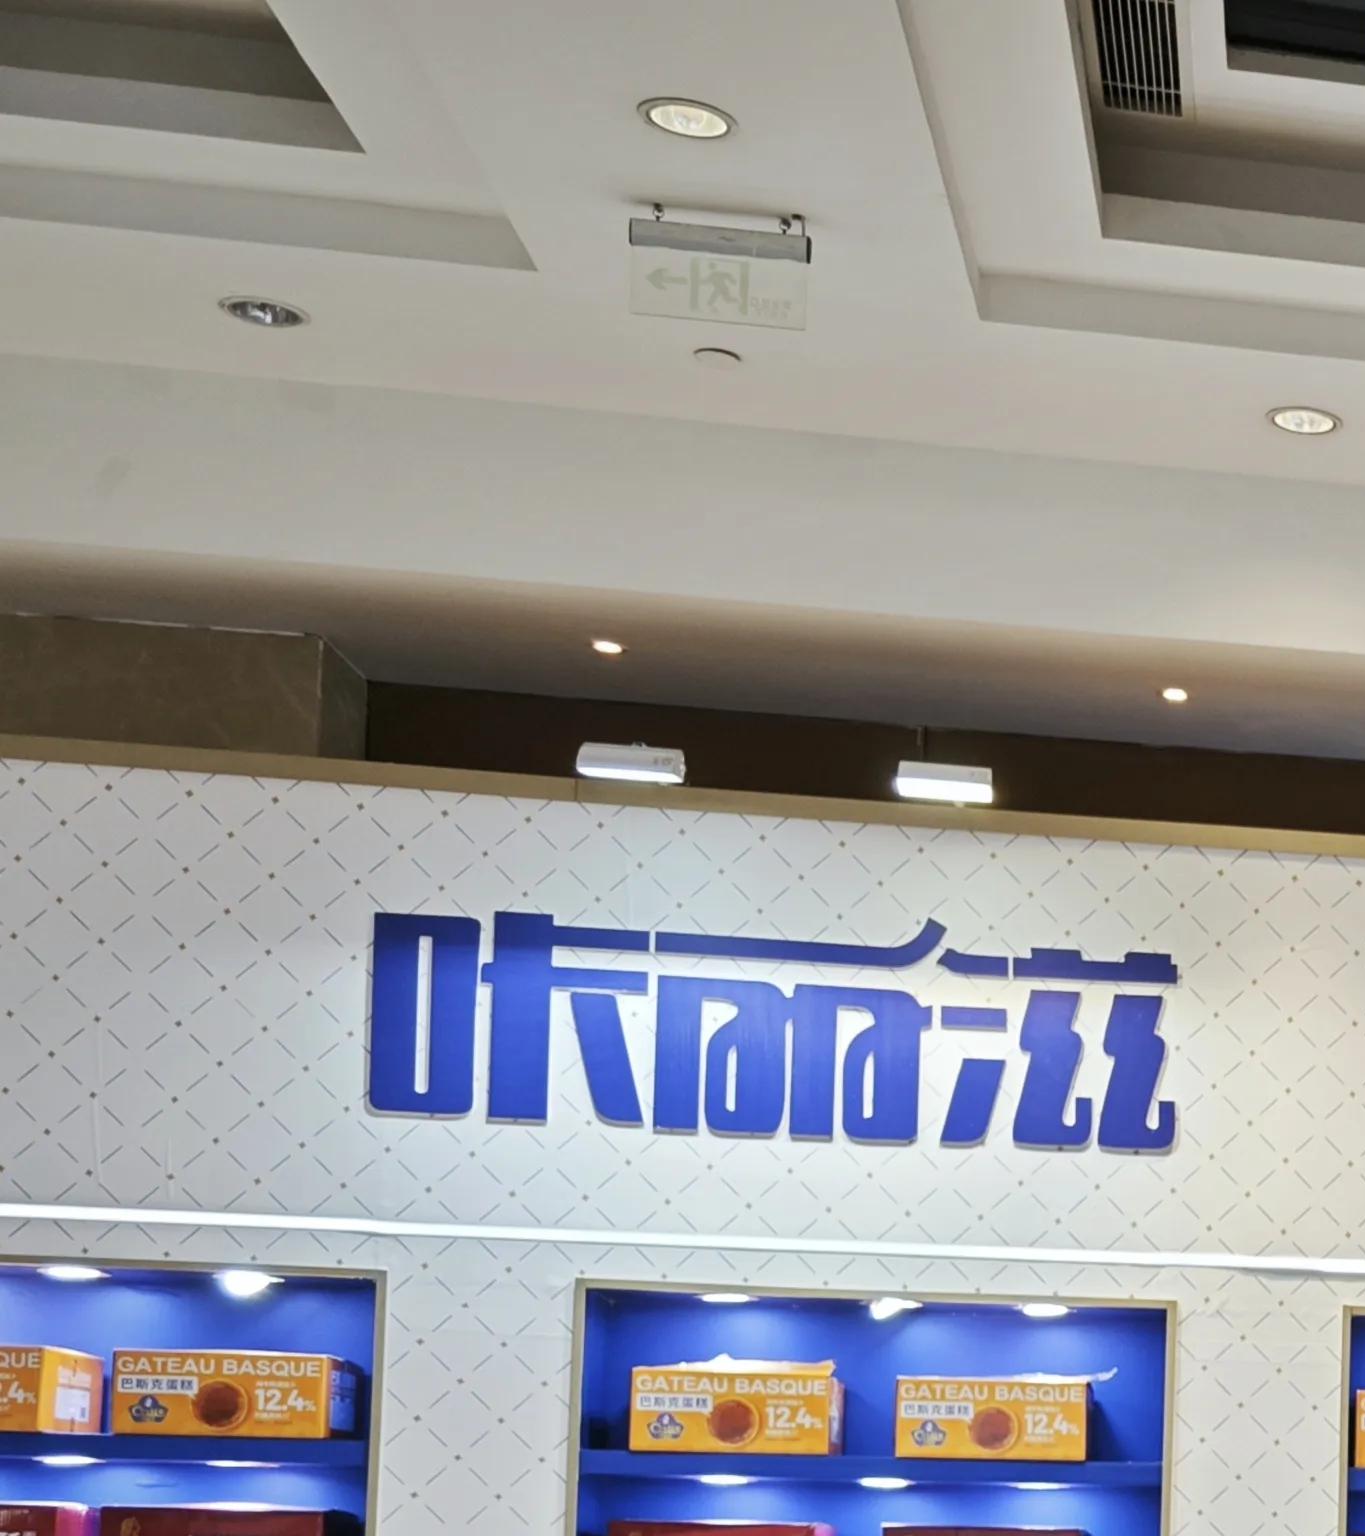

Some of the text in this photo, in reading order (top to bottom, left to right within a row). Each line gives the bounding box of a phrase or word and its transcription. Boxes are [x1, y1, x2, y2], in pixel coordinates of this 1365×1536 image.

[118, 1356, 321, 1377] GATEAU BASQUE
[120, 1377, 196, 1392] 巴斯克蛋糕
[636, 1376, 827, 1395] GATEAU BASQUE
[901, 1384, 1083, 1403] GATEAU BASQUE
